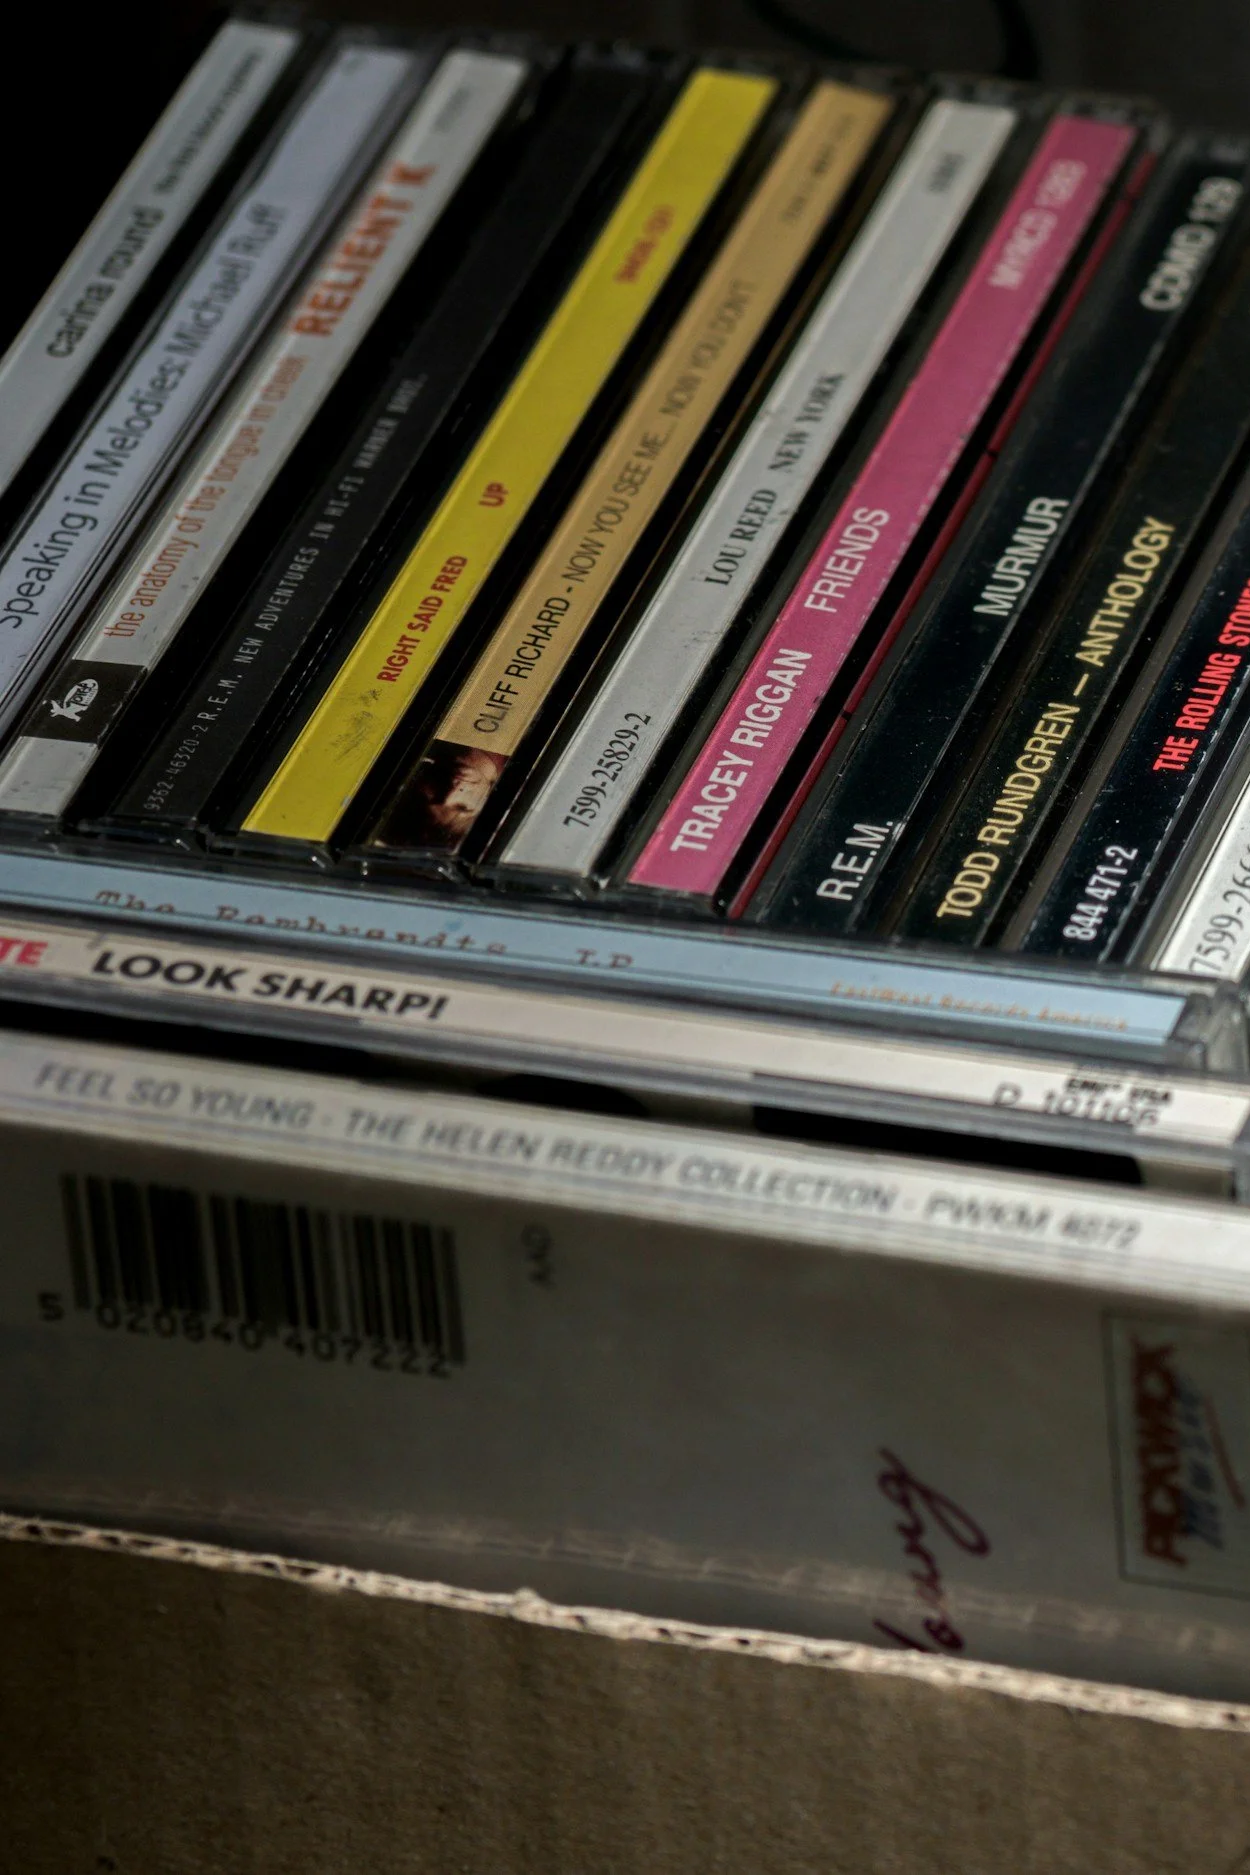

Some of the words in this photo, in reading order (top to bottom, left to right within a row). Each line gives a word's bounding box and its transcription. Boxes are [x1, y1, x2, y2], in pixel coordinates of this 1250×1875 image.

[293, 191, 413, 336] RELIENT
[85, 358, 189, 476] Melodies:
[218, 423, 262, 487] tongue
[64, 481, 110, 506] in
[178, 504, 203, 533] of
[190, 481, 219, 514] the
[103, 606, 145, 639] the
[134, 534, 199, 611] anatomy
[197, 670, 243, 721] R.E.M.
[234, 634, 263, 668] NEW
[255, 544, 321, 630] ADVENTURES
[307, 521, 333, 543] IN
[323, 473, 366, 517] HI-FI
[377, 636, 420, 683] RIGHT
[406, 592, 443, 634] SAID
[431, 555, 469, 592] FRED
[478, 482, 509, 510] UP
[473, 681, 520, 735] CLIFF
[506, 597, 570, 681] RICHARD
[561, 532, 610, 584] NOW
[591, 498, 630, 545] YOU
[613, 461, 652, 496] SEE
[563, 710, 653, 830] 7599-25829-2
[704, 537, 746, 586] LOU
[731, 487, 780, 545] REED
[768, 425, 813, 472] NEW
[803, 369, 848, 427] YORK
[669, 750, 753, 853] TRACEY
[732, 647, 812, 750] RIGGAN
[804, 506, 892, 614] FRIENDS
[816, 818, 896, 903] R.E.M.
[973, 494, 1070, 618] MURMUR
[935, 848, 997, 920] TODD
[978, 701, 1081, 849] RUNDGREN
[1076, 514, 1177, 667] ANTHOLOGY
[1063, 904, 1106, 942] 844
[1085, 845, 1138, 904] 471-2
[1152, 723, 1197, 773] THE
[1176, 651, 1242, 731] ROLLING
[91, 949, 242, 993] LOOK
[253, 970, 450, 1021] SHARP!
[33, 1063, 115, 1101] FEEL
[127, 1076, 183, 1108] SO
[188, 1084, 312, 1130] YOUNG
[345, 1108, 409, 1141] THE
[421, 1122, 535, 1164] HELEN
[547, 1138, 676, 1182] REDDY
[676, 1152, 899, 1215] COLLECTION
